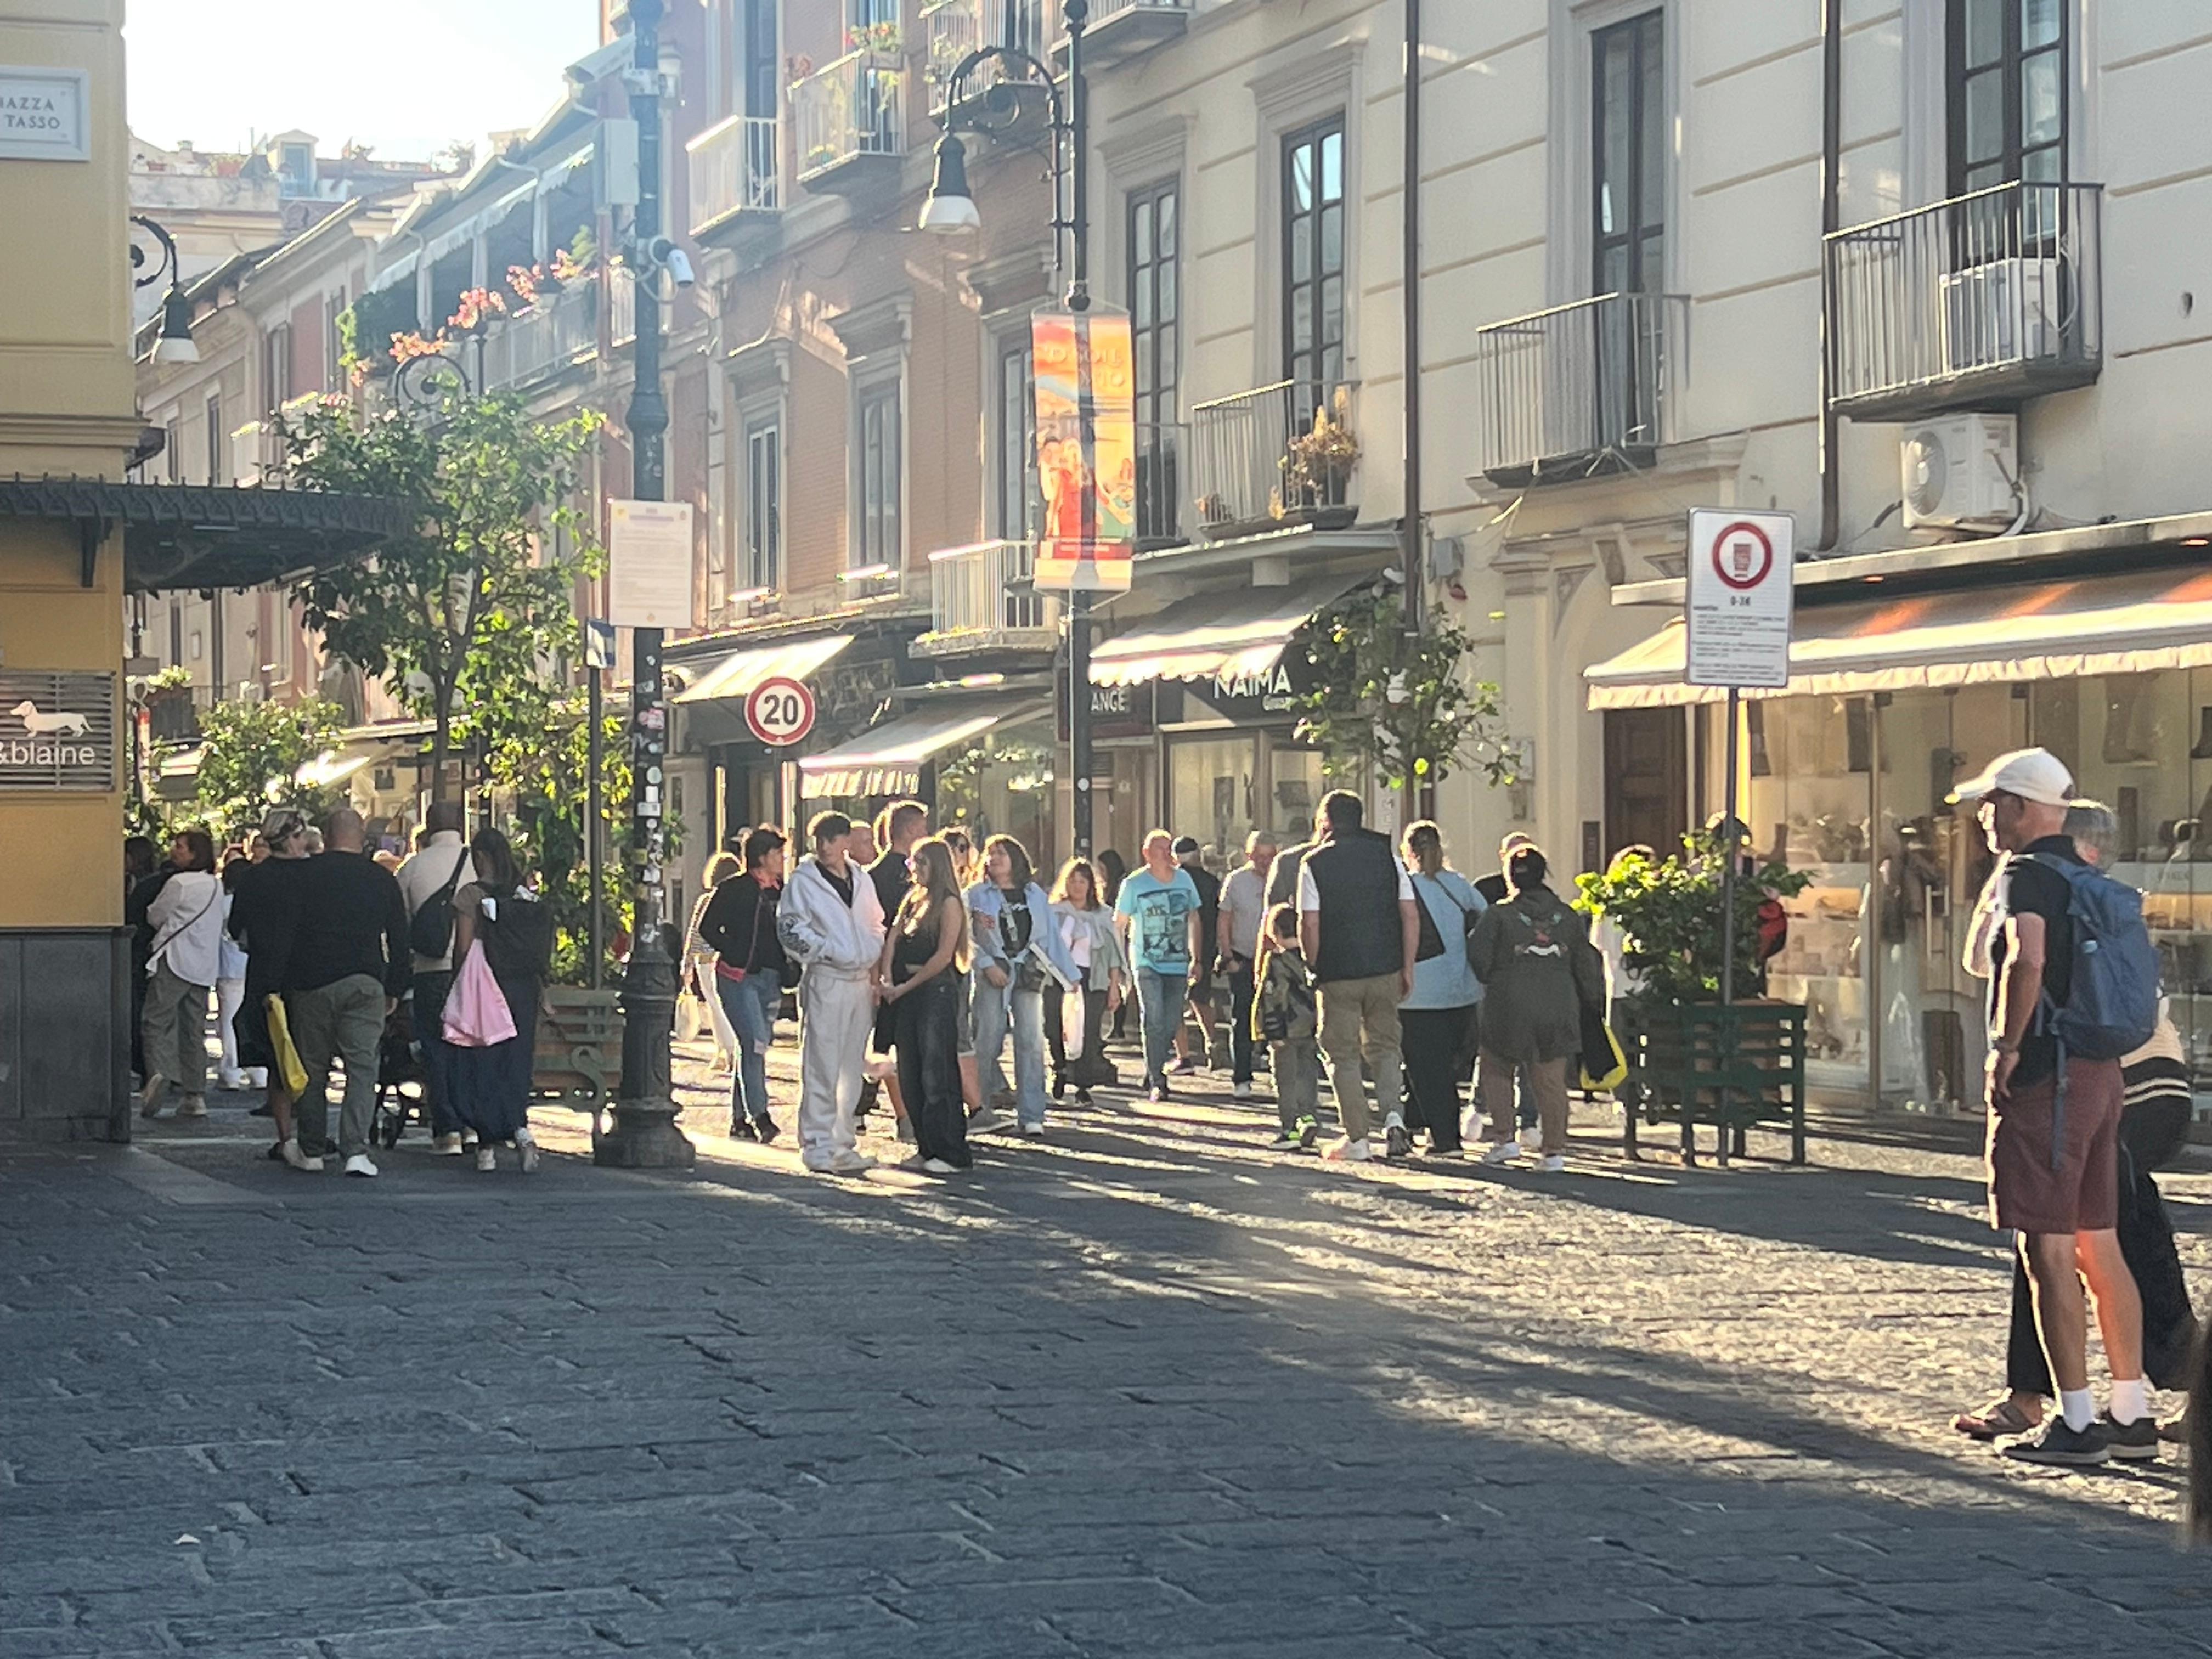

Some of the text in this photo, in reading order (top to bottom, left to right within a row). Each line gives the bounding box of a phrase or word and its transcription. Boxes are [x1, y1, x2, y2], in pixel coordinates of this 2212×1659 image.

[4, 114, 60, 129] TASSO
[1214, 664, 1293, 699] NAIMA
[763, 694, 798, 725] 20
